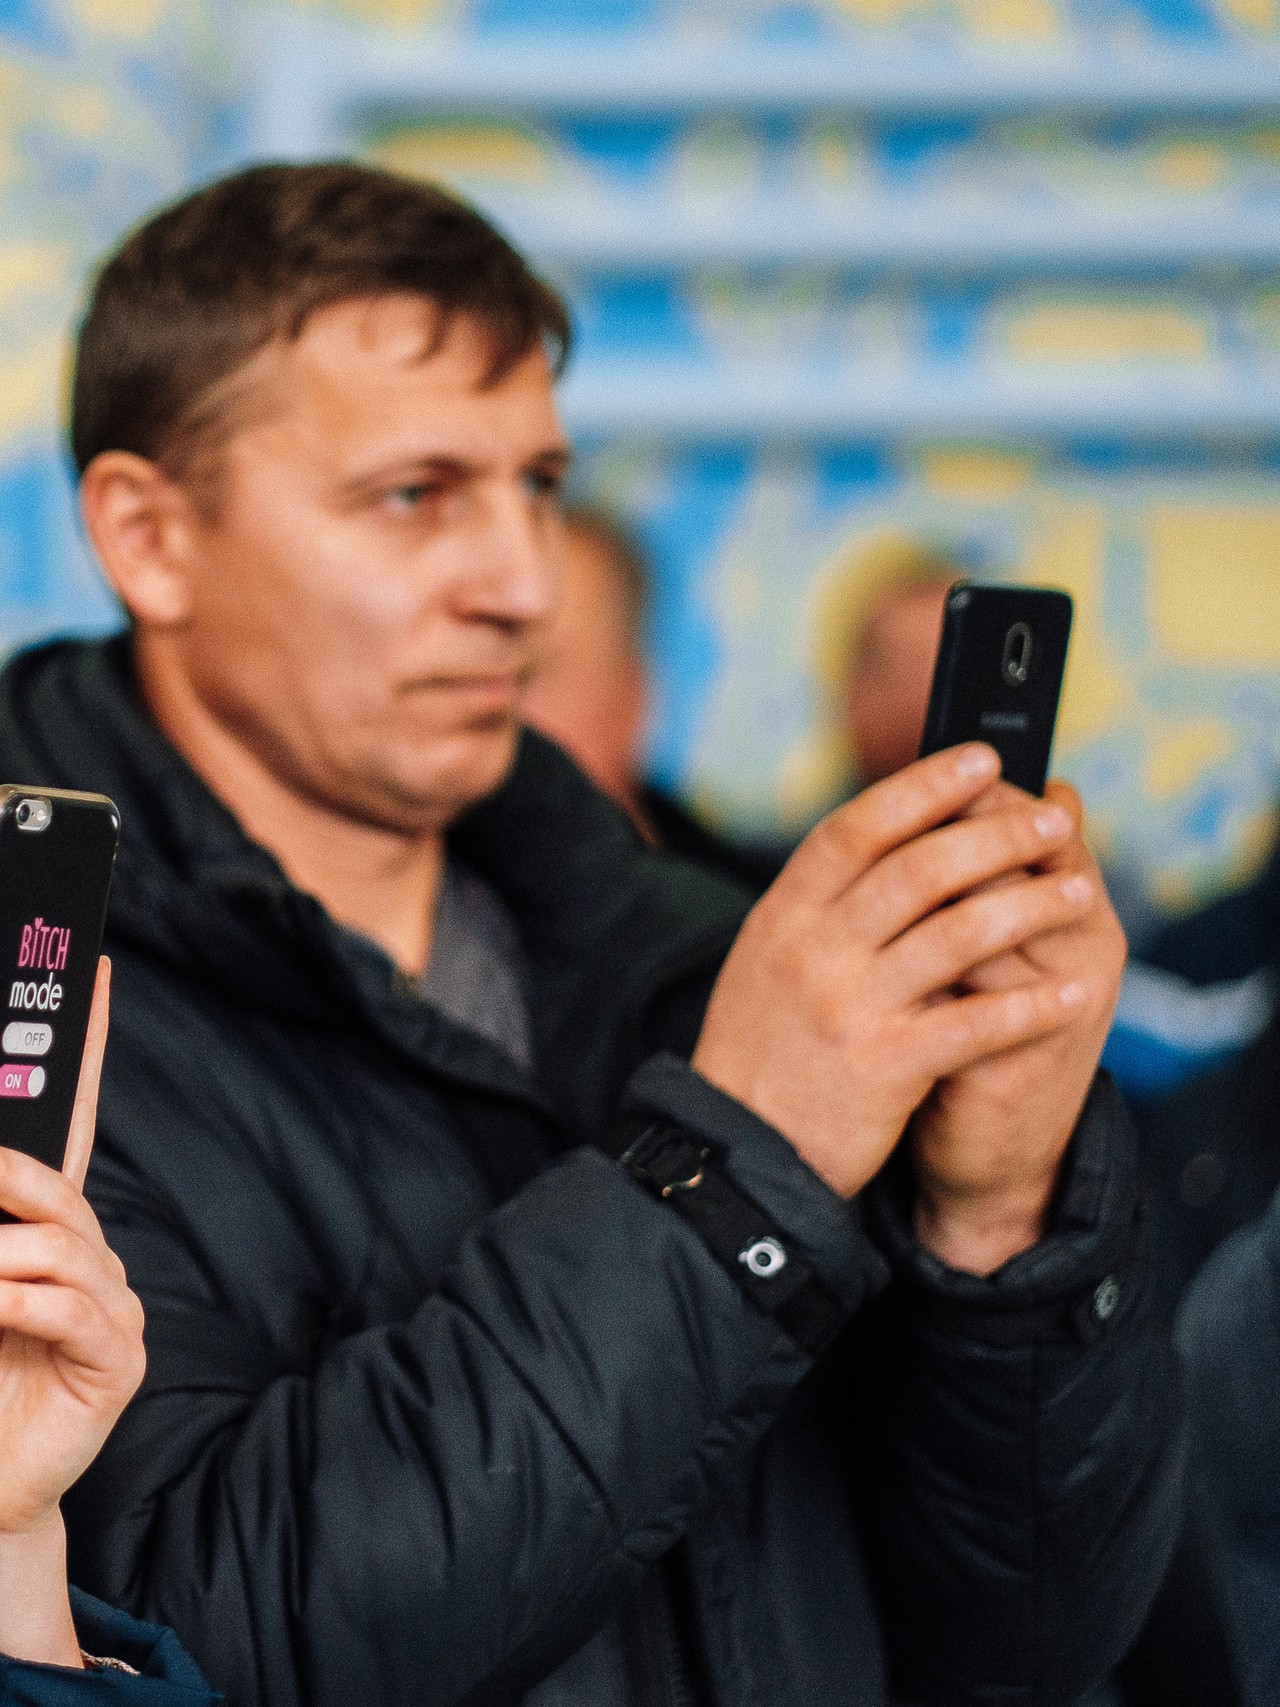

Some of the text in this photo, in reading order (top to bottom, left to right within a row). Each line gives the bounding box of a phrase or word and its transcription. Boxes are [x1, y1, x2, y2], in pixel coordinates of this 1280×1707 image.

[9, 972, 63, 1010] mode
[24, 1031, 46, 1047] OFF
[5, 1073, 22, 1088] ON
